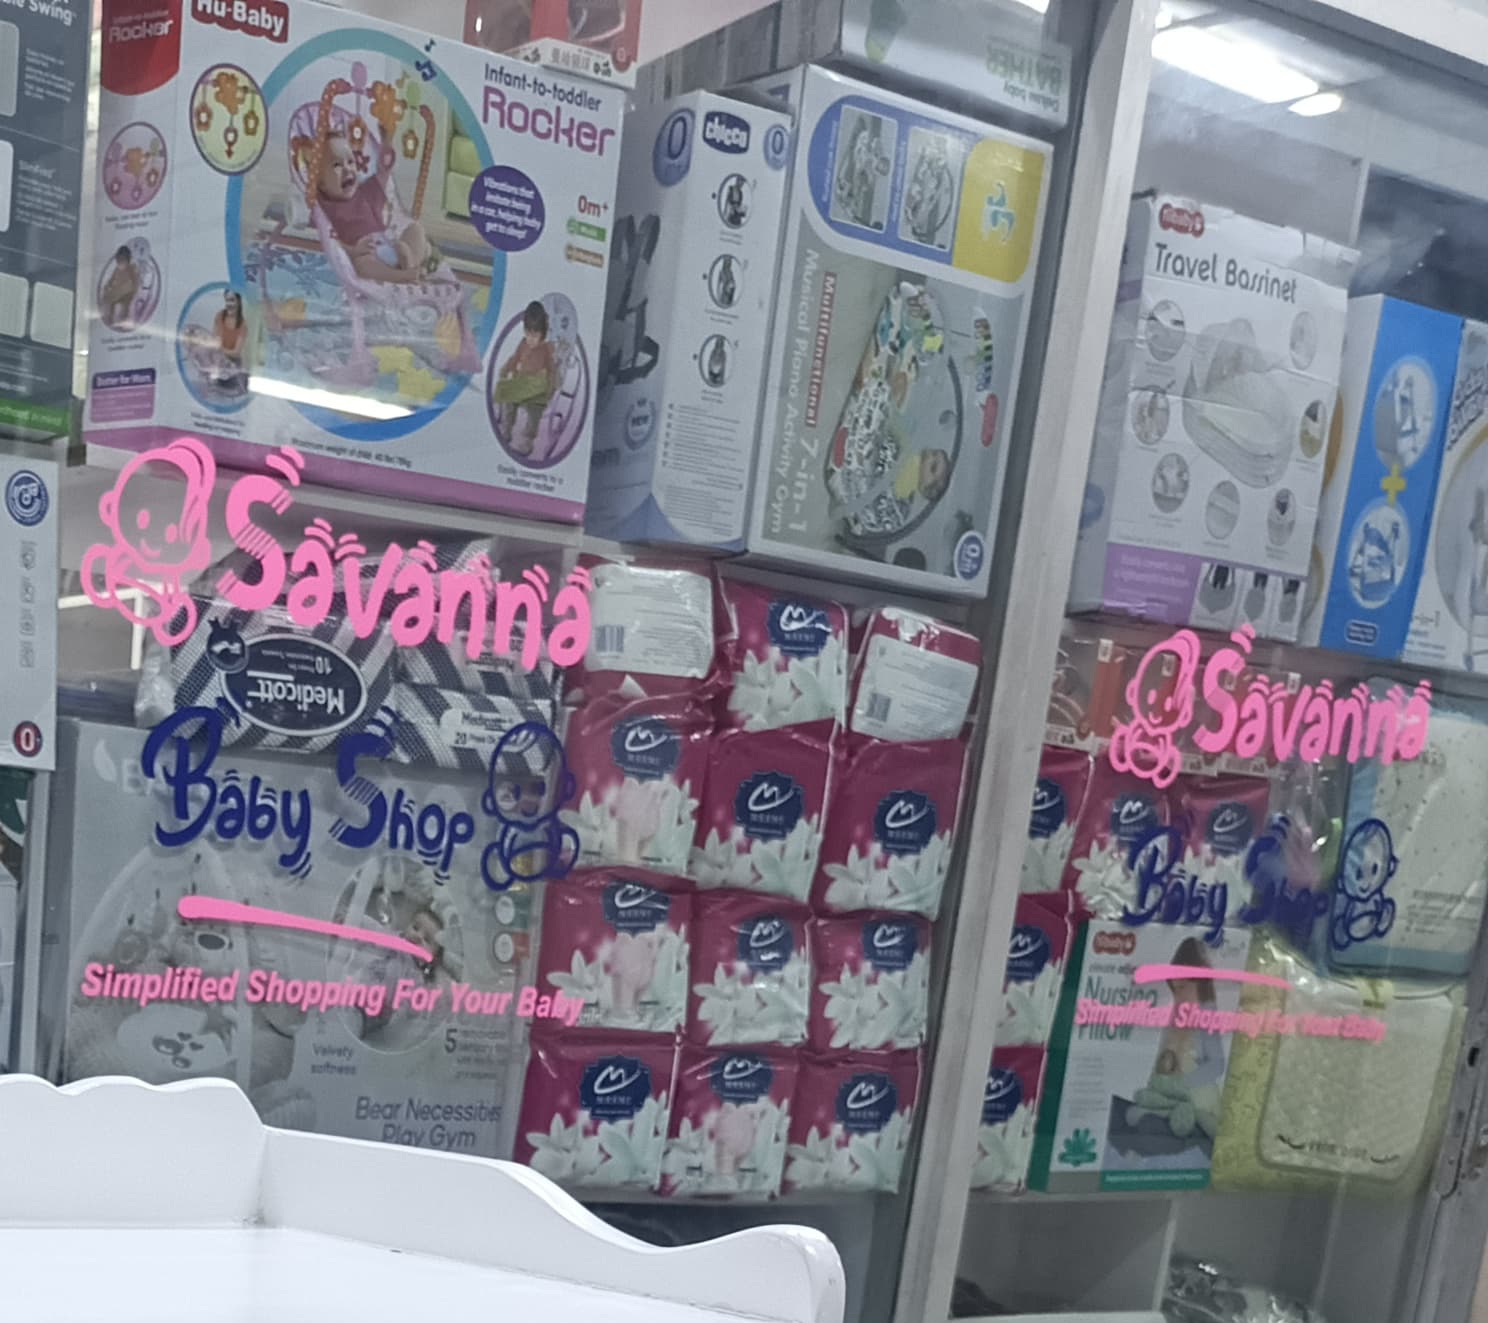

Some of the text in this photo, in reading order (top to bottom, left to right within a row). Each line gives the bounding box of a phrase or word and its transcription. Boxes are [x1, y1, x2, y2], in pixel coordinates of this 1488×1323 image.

[30, 0, 74, 26] Swing
[484, 63, 602, 112] Infant-to-toddler
[482, 86, 616, 156] Rocker
[667, 116, 688, 159] 0
[1155, 242, 1297, 304] Travel Bassinet
[806, 274, 836, 426] Multifunctional
[770, 249, 820, 533] Musical Piano Activity Gym
[216, 472, 592, 671] Savanna
[248, 679, 346, 715] Medicott
[1192, 648, 1430, 764] Savanna
[142, 706, 477, 874] Baby Shop
[1122, 825, 1229, 949] Baby
[81, 962, 584, 1027] Simplified Shopping For Your Baby
[444, 1028, 458, 1053] 5
[355, 1096, 401, 1120] Bear
[382, 1123, 477, 1150] Play Gym
